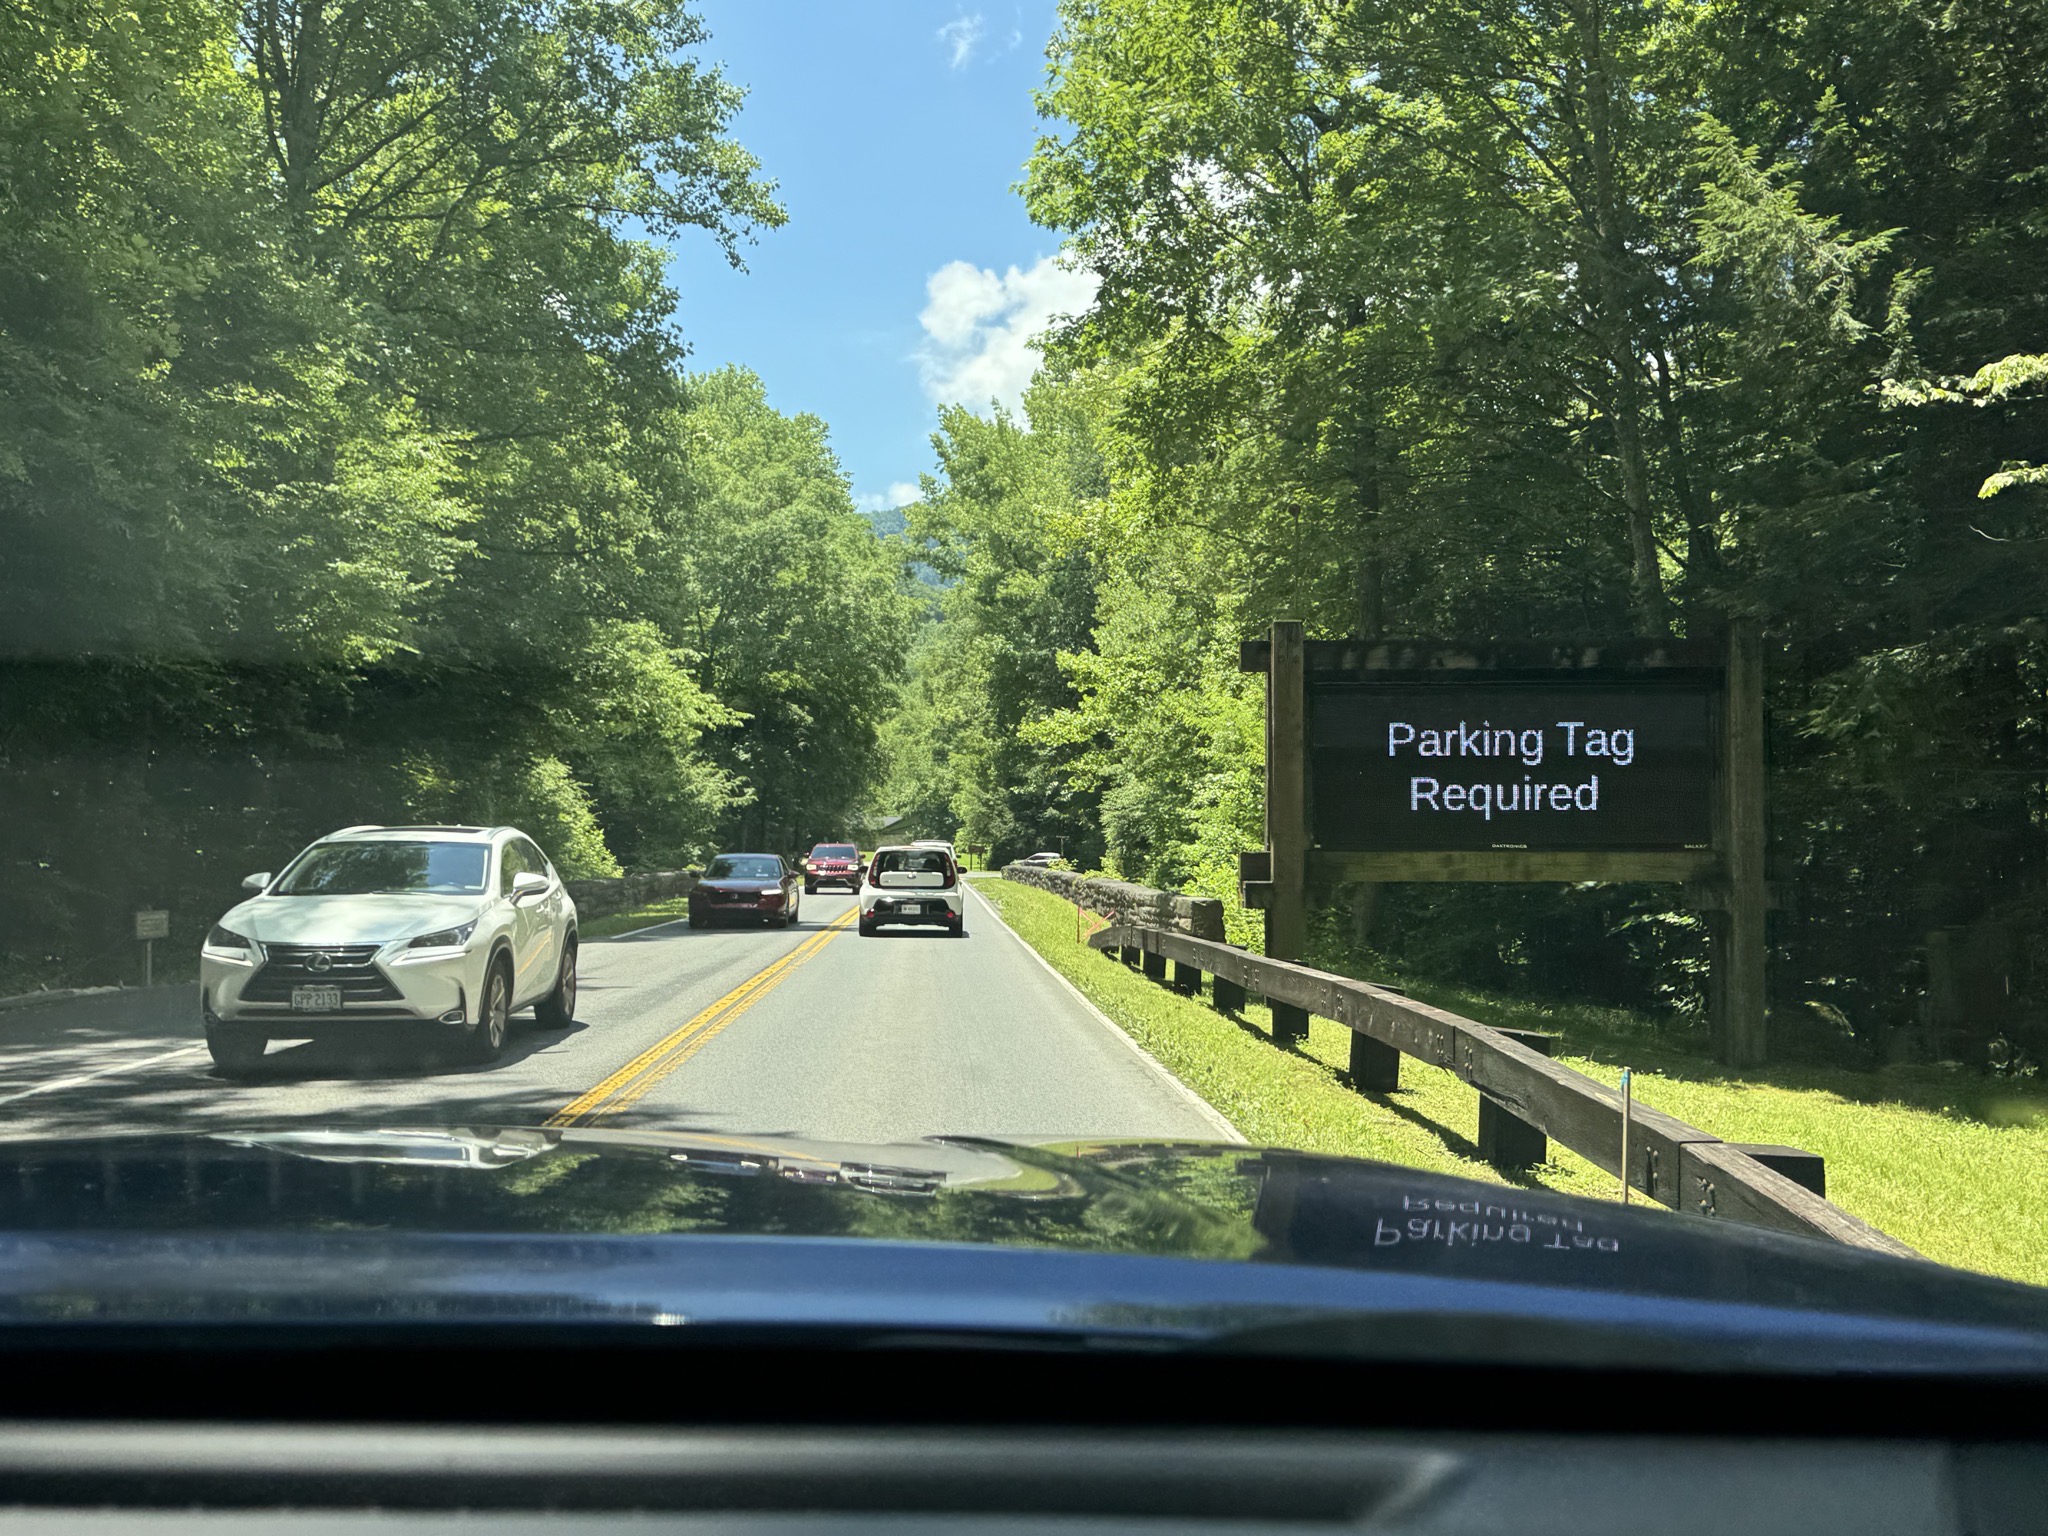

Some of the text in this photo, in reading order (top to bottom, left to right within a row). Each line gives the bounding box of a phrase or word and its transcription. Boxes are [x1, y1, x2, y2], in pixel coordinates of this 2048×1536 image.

[1388, 720, 1635, 766] Parking Tag
[1410, 774, 1599, 821] Required
